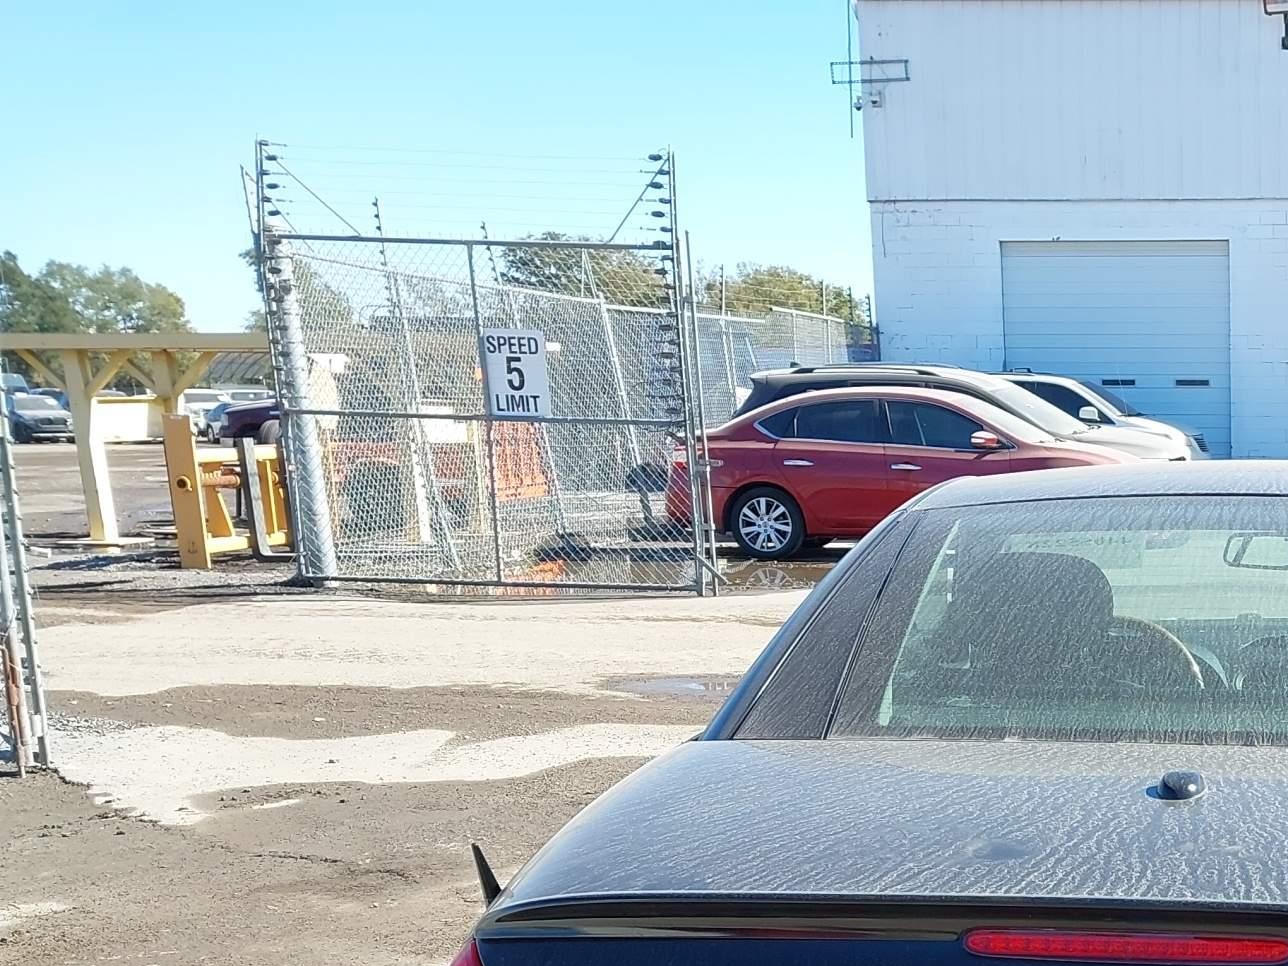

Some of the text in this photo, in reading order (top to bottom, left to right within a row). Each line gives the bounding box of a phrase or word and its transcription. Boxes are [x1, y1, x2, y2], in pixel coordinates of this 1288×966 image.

[486, 335, 539, 355] SPEED
[505, 356, 525, 391] 5
[495, 394, 540, 412] LIMIT
